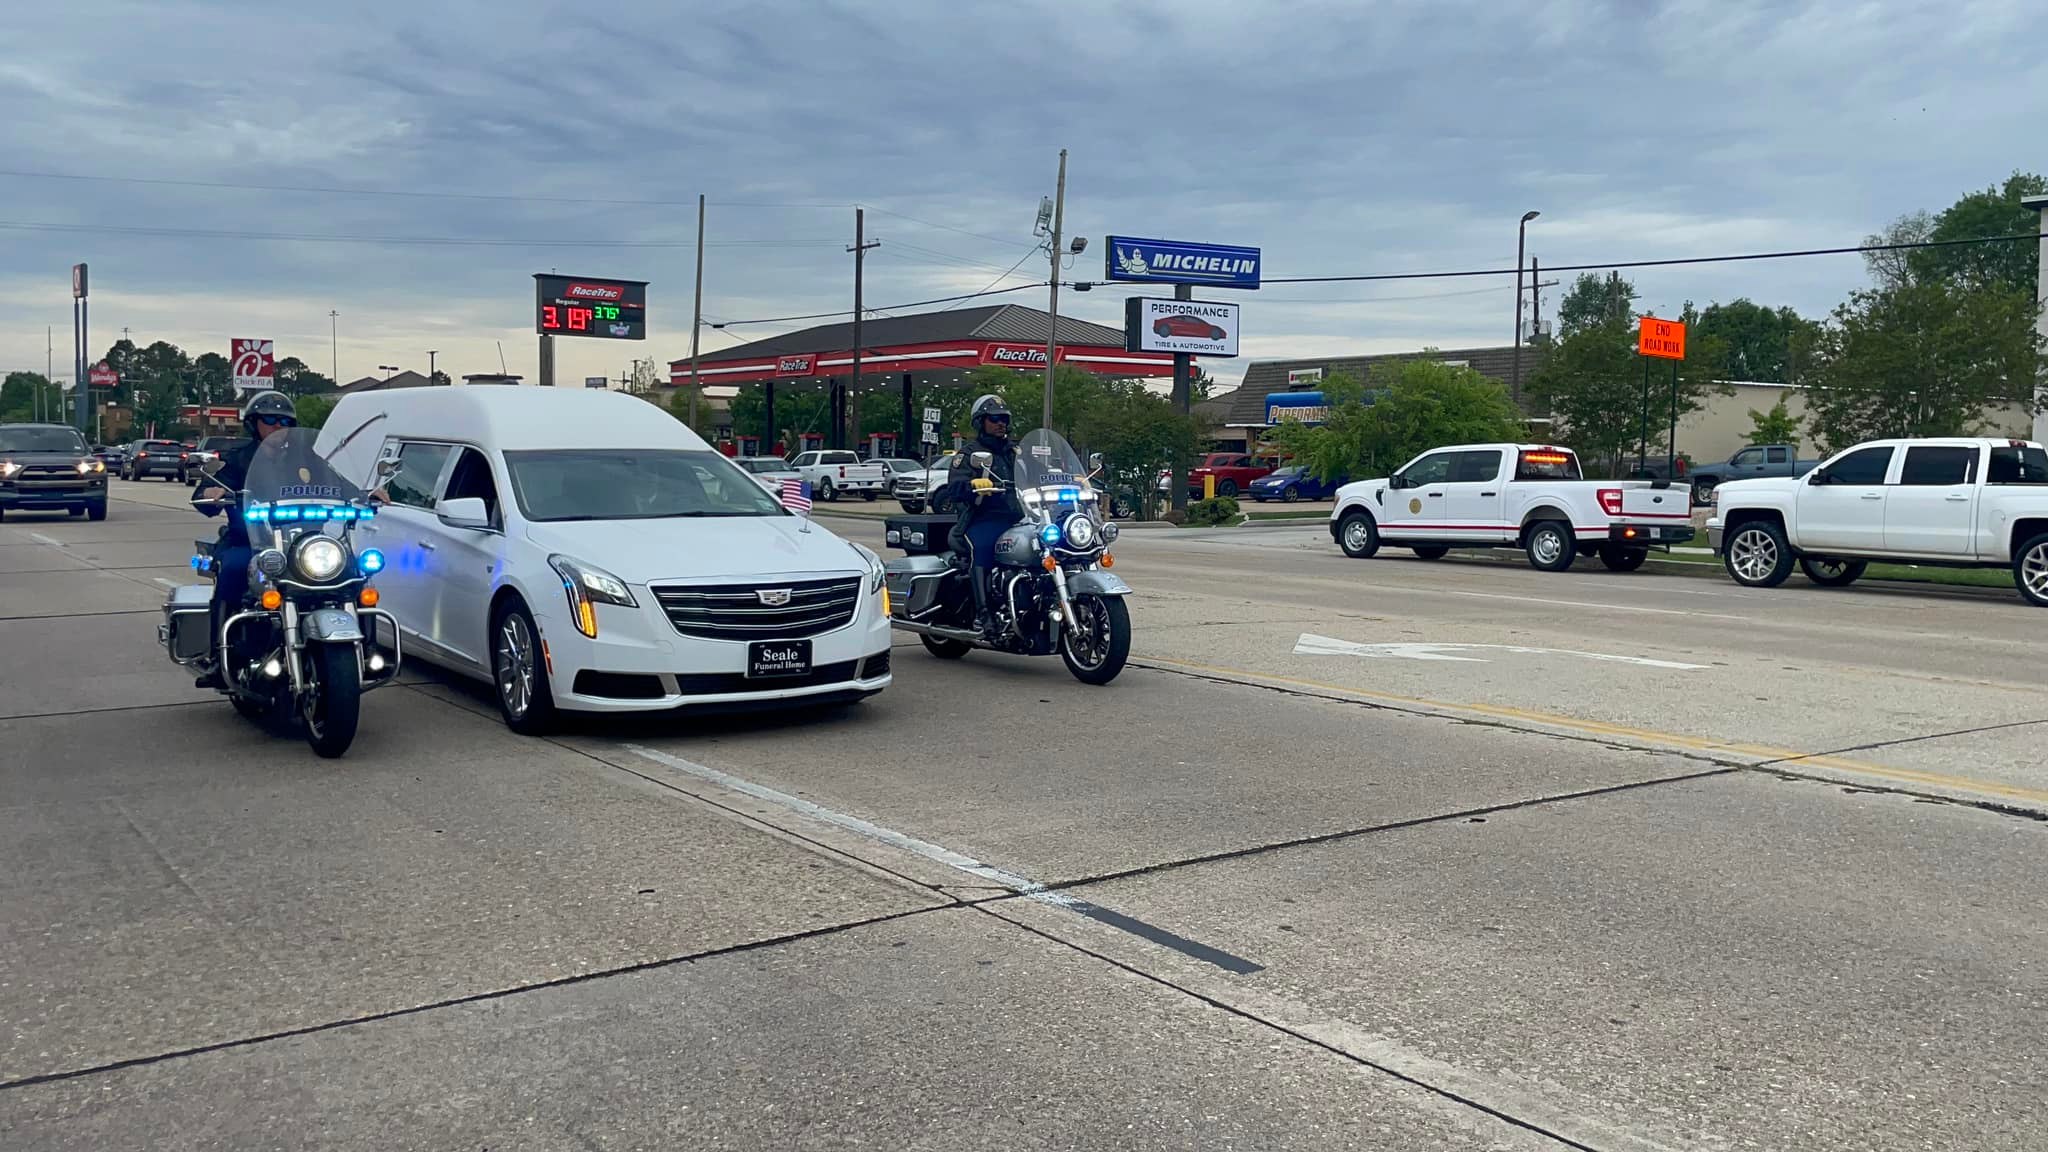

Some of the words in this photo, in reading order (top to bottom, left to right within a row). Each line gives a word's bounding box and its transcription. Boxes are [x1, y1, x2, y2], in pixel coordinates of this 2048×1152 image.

[1152, 253, 1256, 274] MICHELIN
[572, 286, 618, 298] RaceTrac
[1151, 303, 1230, 319] PERFORMANCE
[1655, 323, 1671, 337] END
[1179, 344, 1225, 352] AUTOMOTIVE
[1644, 338, 1662, 351] ROAD
[1663, 341, 1680, 353] WORK
[780, 359, 809, 371] RaceTrac
[924, 410, 940, 421] JCT
[280, 485, 342, 498] POLICE
[762, 648, 798, 662] Seale
[754, 661, 784, 670] Funeral
[785, 661, 806, 669] Home
